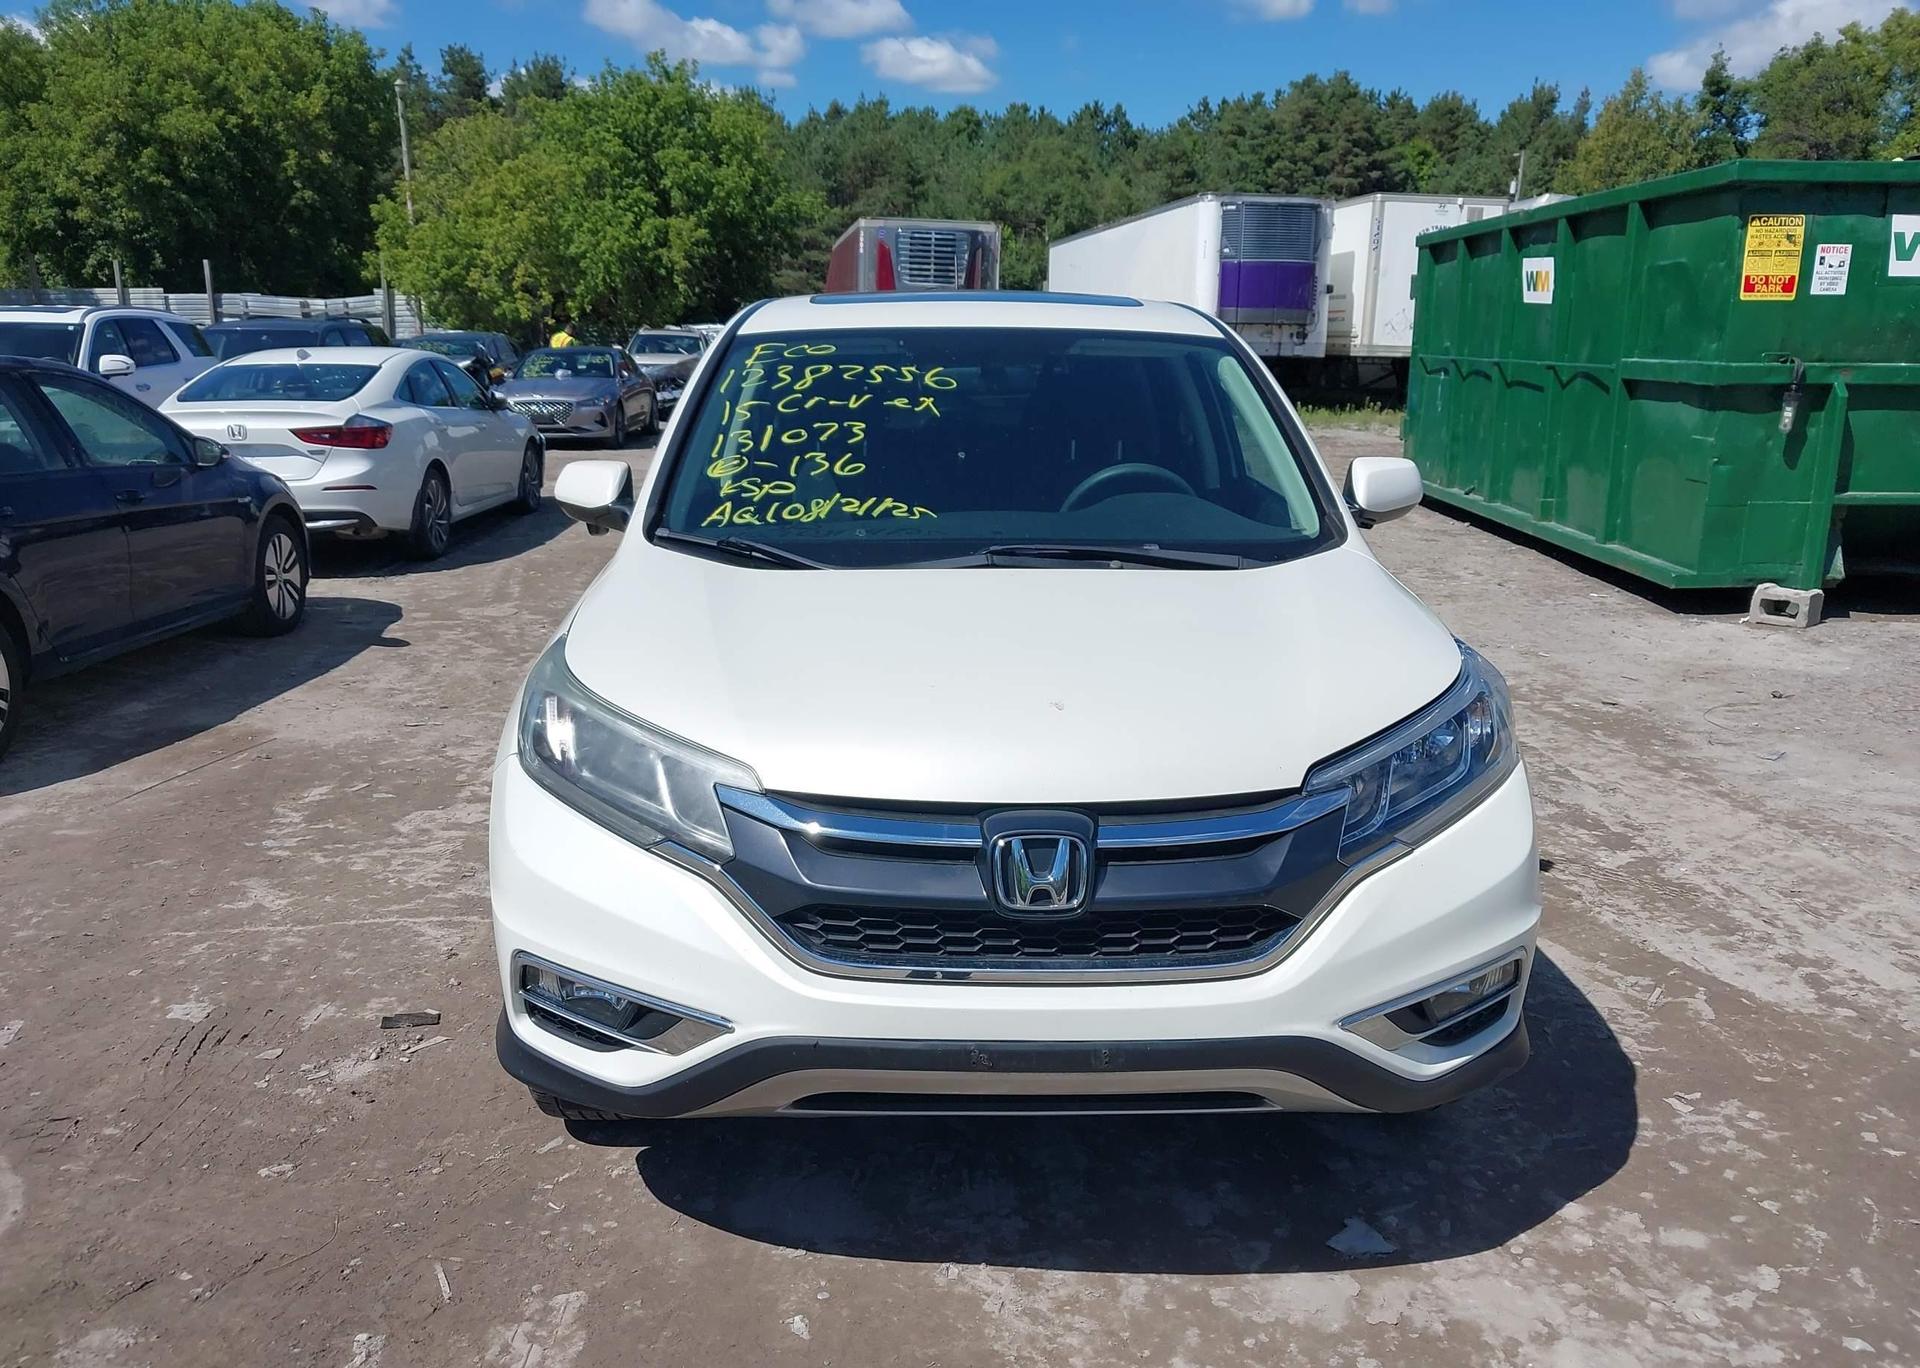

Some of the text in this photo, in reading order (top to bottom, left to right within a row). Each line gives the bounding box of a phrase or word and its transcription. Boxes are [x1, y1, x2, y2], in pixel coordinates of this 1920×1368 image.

[1760, 217, 1803, 226] CAUTION
[1820, 246, 1849, 254] NOTICE
[1525, 270, 1550, 292] WM
[1750, 275, 1791, 284] DO NOT
[1754, 284, 1784, 293] PARK
[711, 421, 867, 458] 131073
